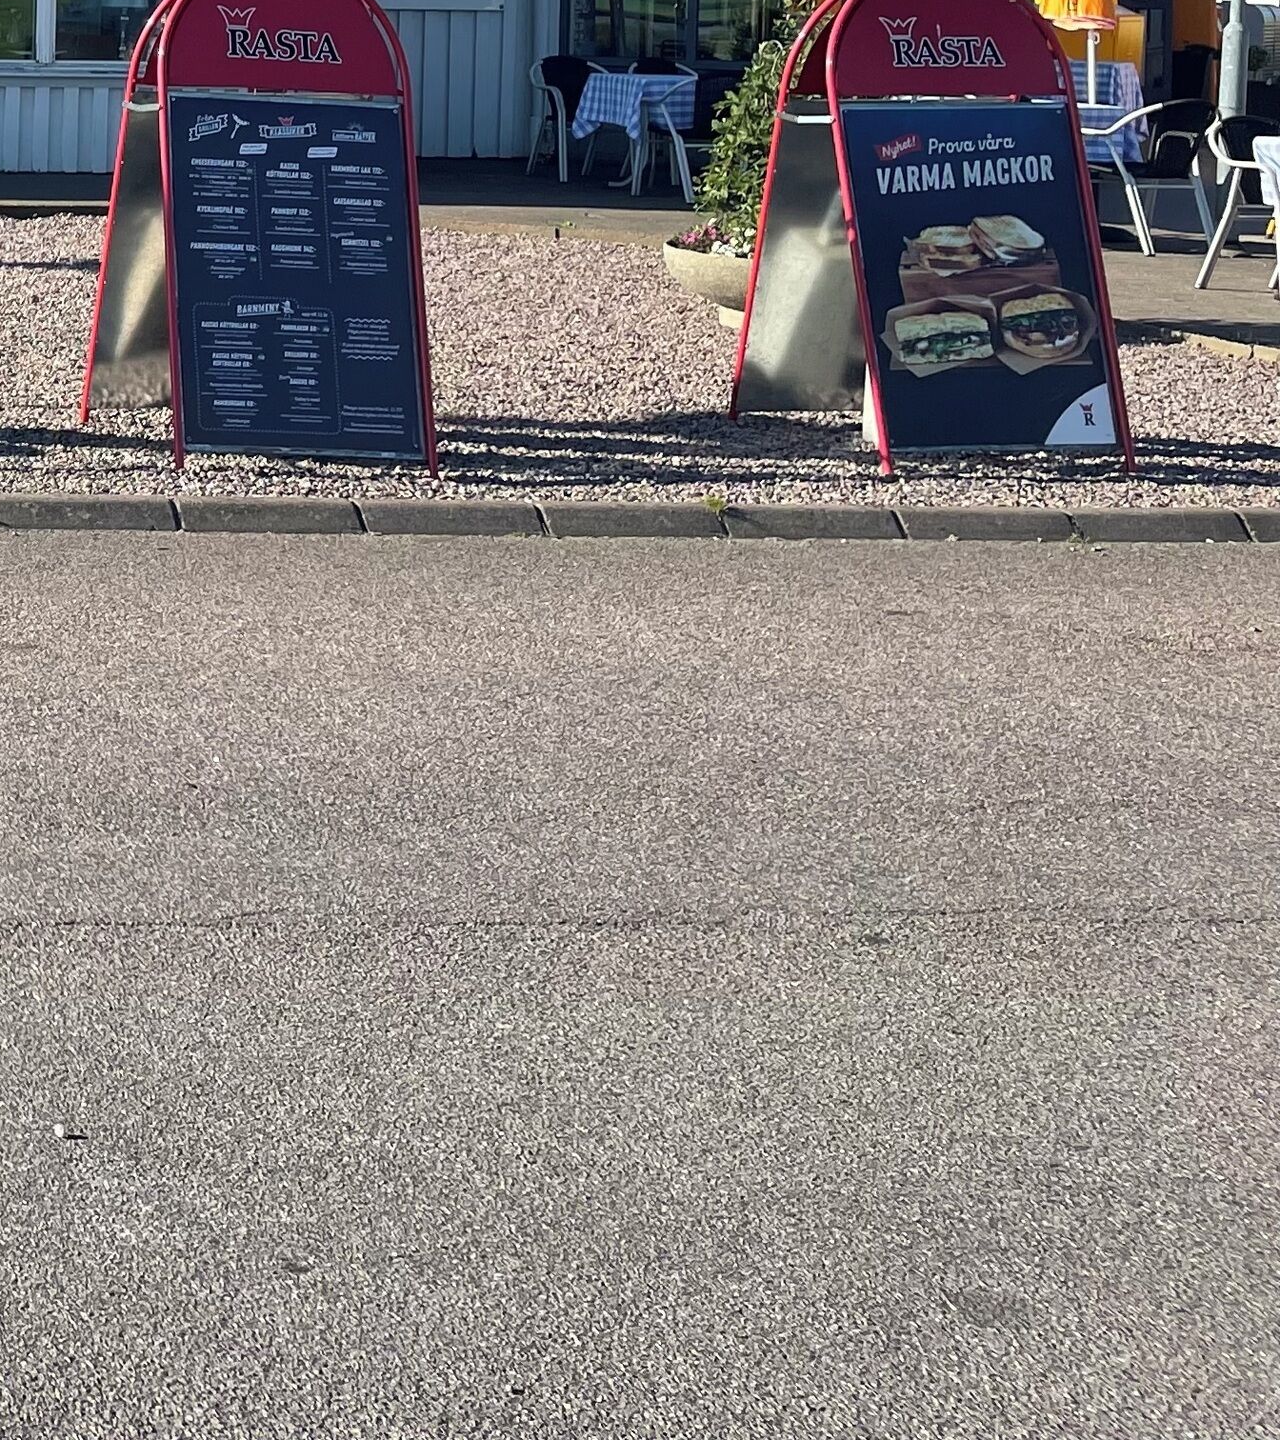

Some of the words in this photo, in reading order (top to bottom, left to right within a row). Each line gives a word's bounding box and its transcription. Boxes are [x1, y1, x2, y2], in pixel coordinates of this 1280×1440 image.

[226, 28, 342, 64] RASTA
[891, 37, 1006, 67] RASTA
[882, 136, 917, 159] Nyhet!
[928, 138, 975, 155] Prova
[978, 133, 1015, 150] våra
[876, 162, 956, 195] VARMA
[963, 155, 1055, 188] MACKOR
[237, 303, 280, 314] BARNMENY
[1083, 412, 1097, 427] R
